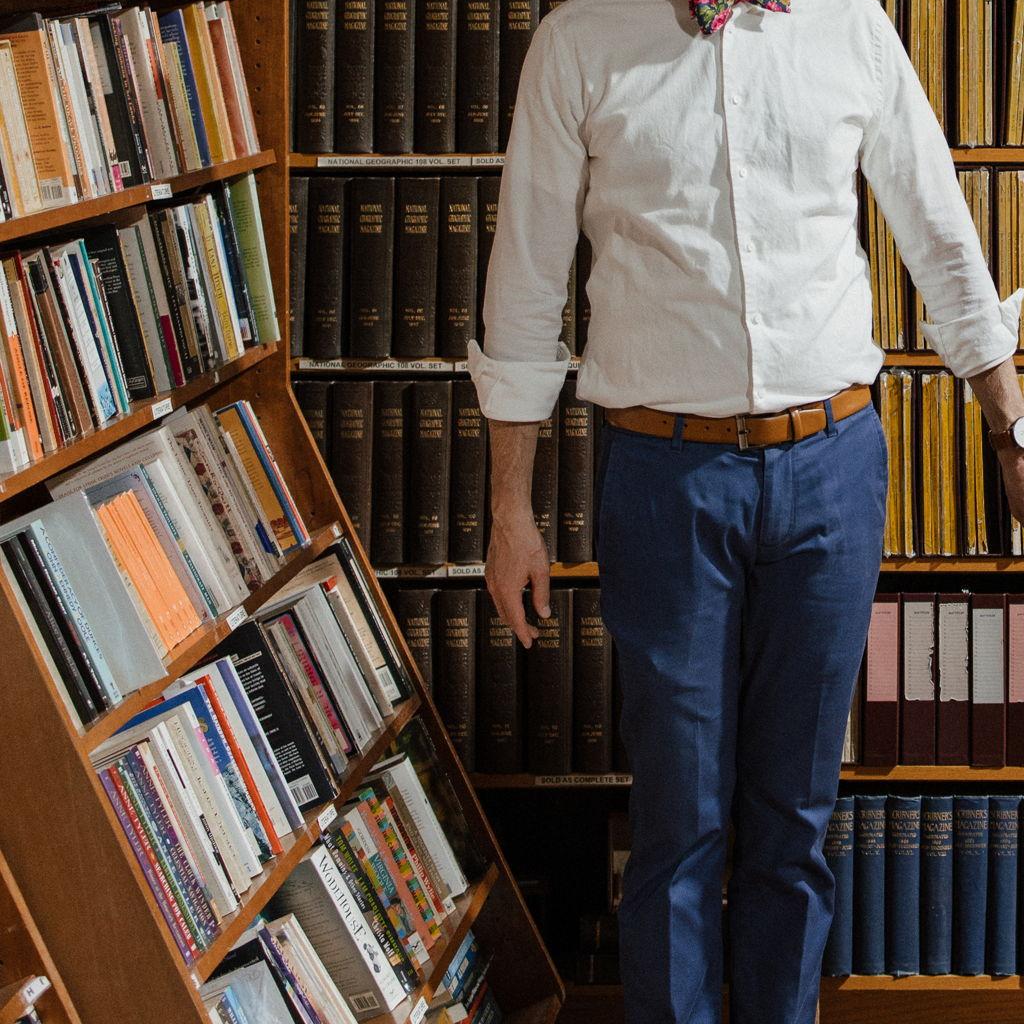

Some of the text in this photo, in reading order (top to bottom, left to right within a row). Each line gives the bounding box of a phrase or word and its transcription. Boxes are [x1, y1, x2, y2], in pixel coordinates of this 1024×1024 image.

[39, 526, 103, 660] A CONFEDERACY OF DUNCES
[109, 789, 144, 856] ANNE TYLER
[117, 783, 192, 939] ANNE TYLER SEARCHING FOR CALEB
[156, 835, 200, 922] ANNE TYLER
[315, 854, 369, 941] WODEHOUSE
[321, 833, 335, 849] What
[331, 850, 350, 875] Remains
[347, 879, 358, 893] Other
[354, 892, 367, 909] Stories
[334, 835, 347, 851] TOM
[342, 850, 358, 873] WOLFE
[357, 880, 368, 892] AM
[363, 892, 389, 930] CHARLOTTE
[384, 930, 406, 962] SIMMONS
[372, 854, 394, 895] VIRGINIA
[410, 853, 436, 899] Philip Wylie
[369, 919, 395, 957] Christa Wolf
